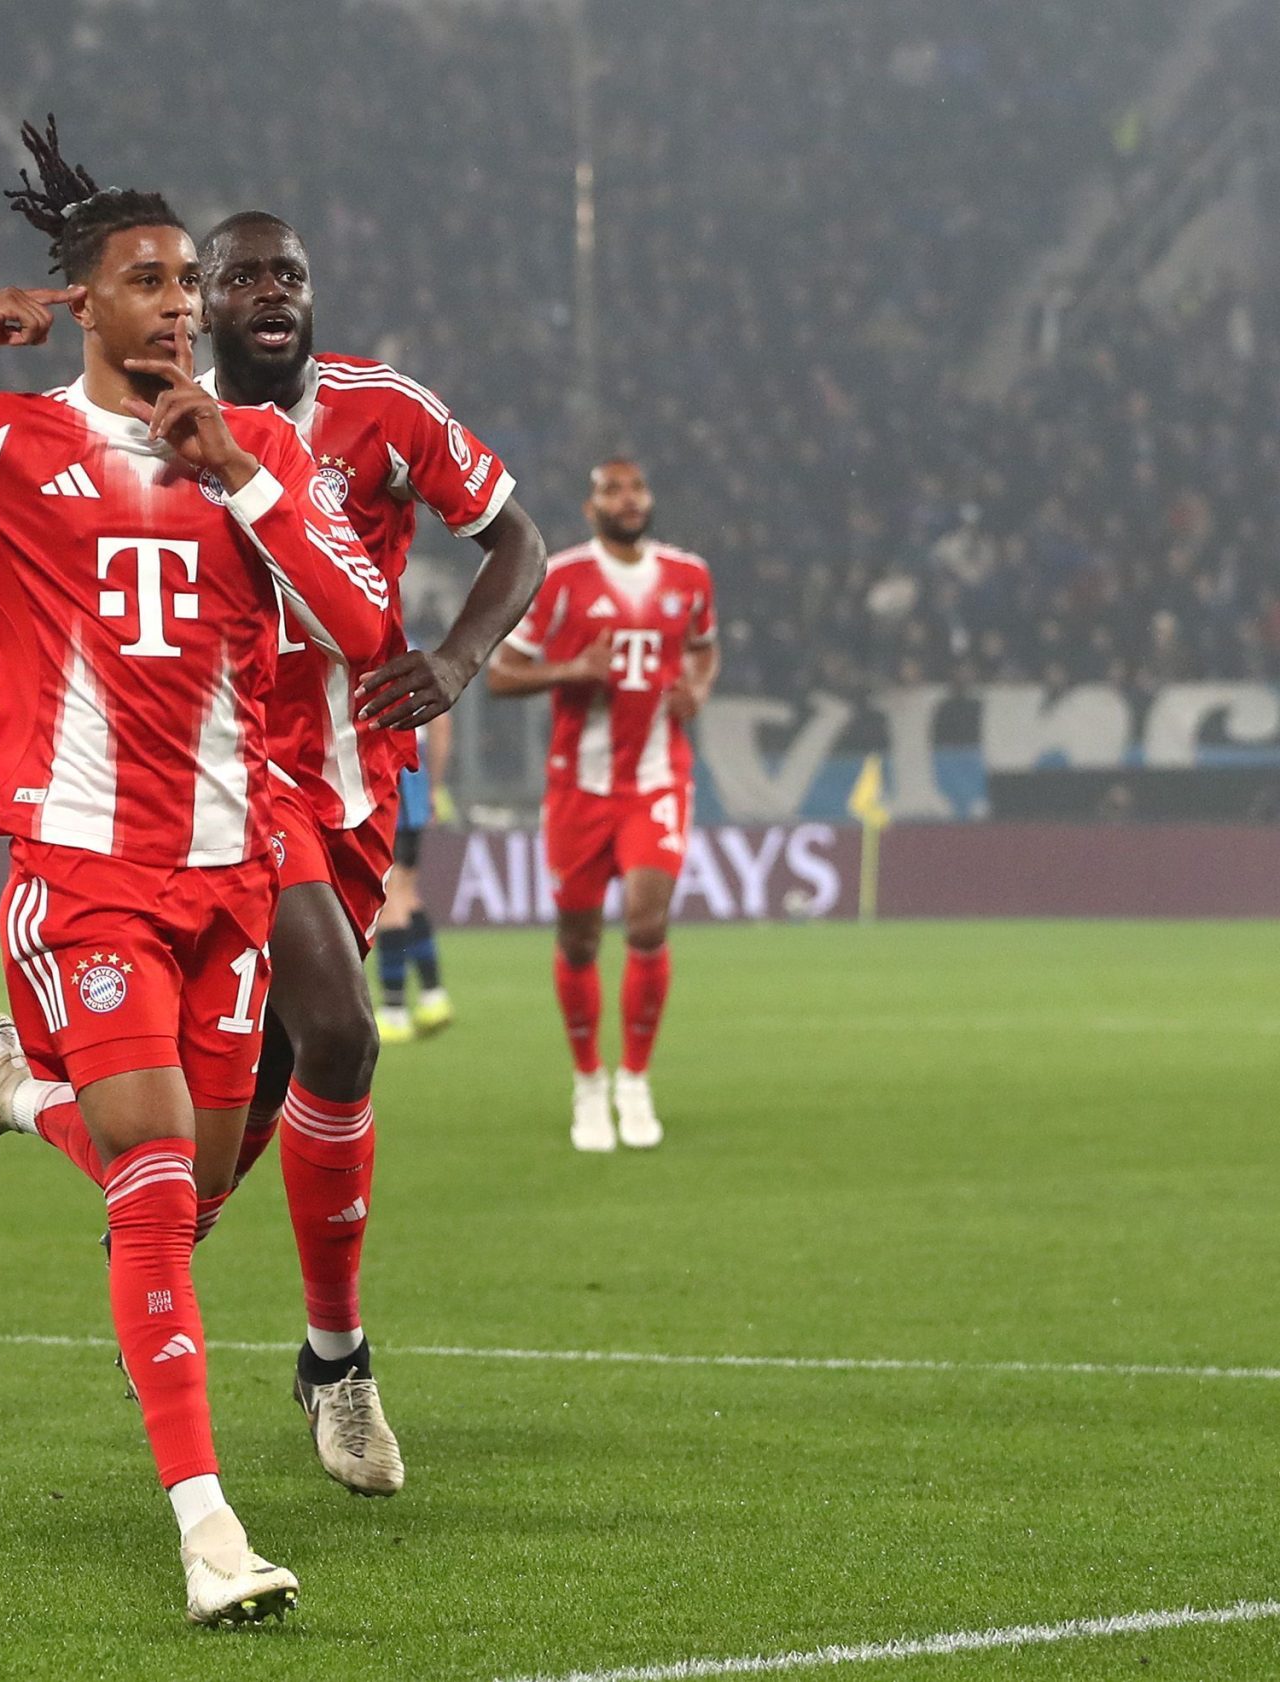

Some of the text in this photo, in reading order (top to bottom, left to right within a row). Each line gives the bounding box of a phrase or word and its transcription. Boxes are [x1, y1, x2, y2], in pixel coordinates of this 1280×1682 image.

[96, 537, 200, 657] T
[609, 629, 662, 691] T
[451, 824, 841, 923] AIAYS
[90, 969, 121, 984] BAYERN
[217, 941, 271, 1034] 1
